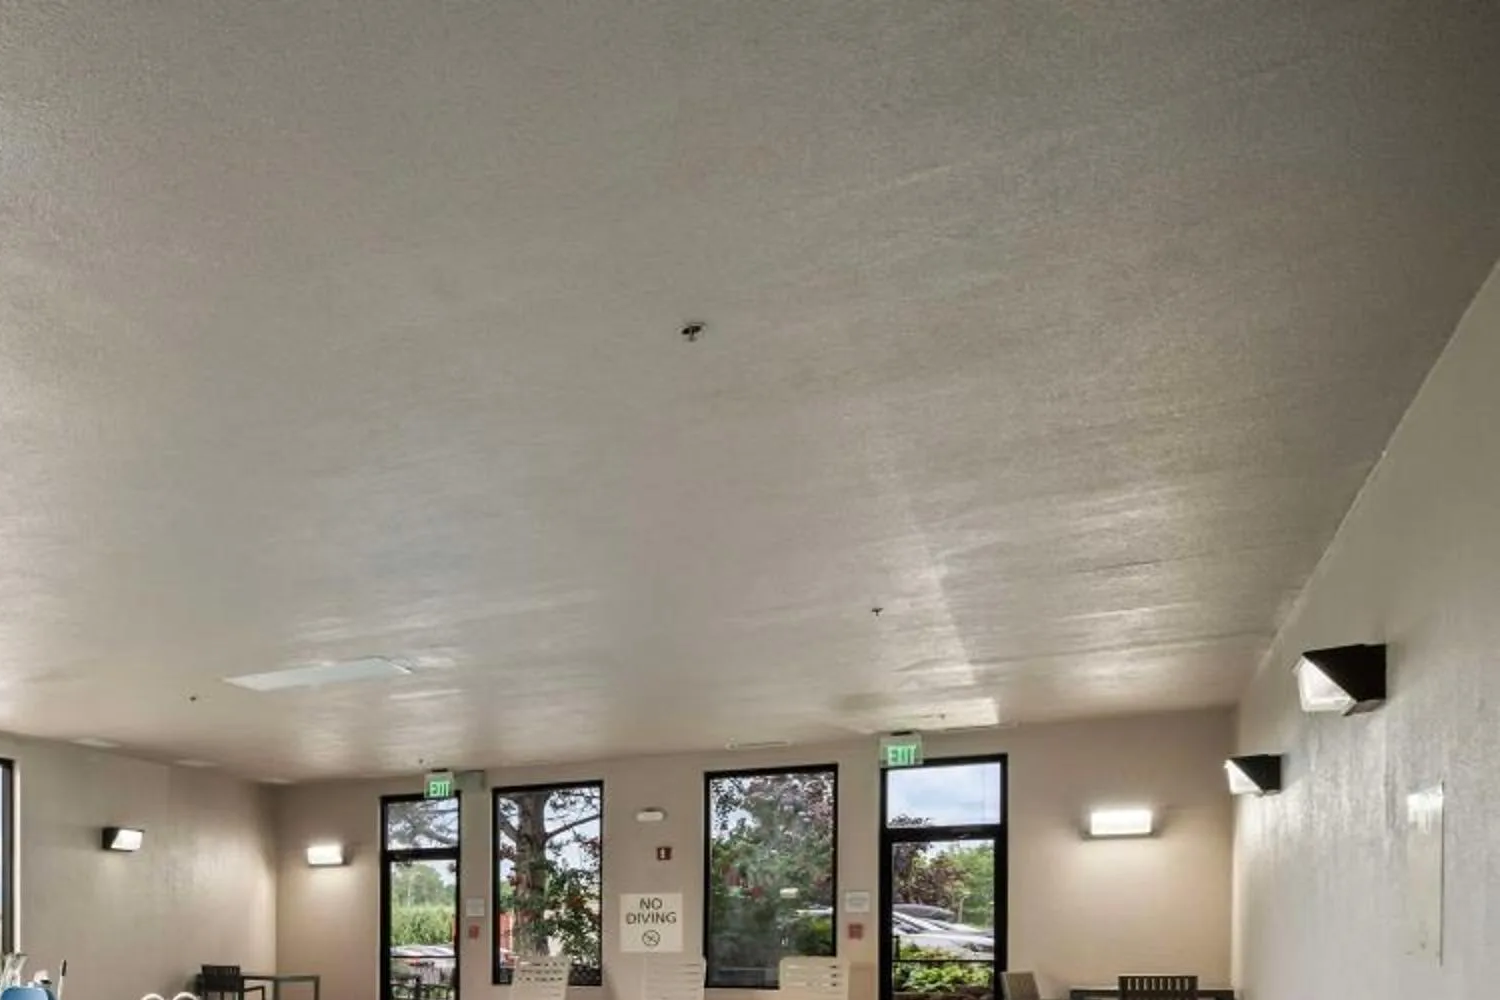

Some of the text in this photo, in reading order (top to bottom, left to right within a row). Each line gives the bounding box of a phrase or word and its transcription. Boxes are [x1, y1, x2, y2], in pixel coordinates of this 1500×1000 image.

[887, 745, 916, 767] EXIT
[429, 781, 450, 797] EXIT
[639, 897, 663, 910] NO
[625, 911, 677, 925] DIVING
